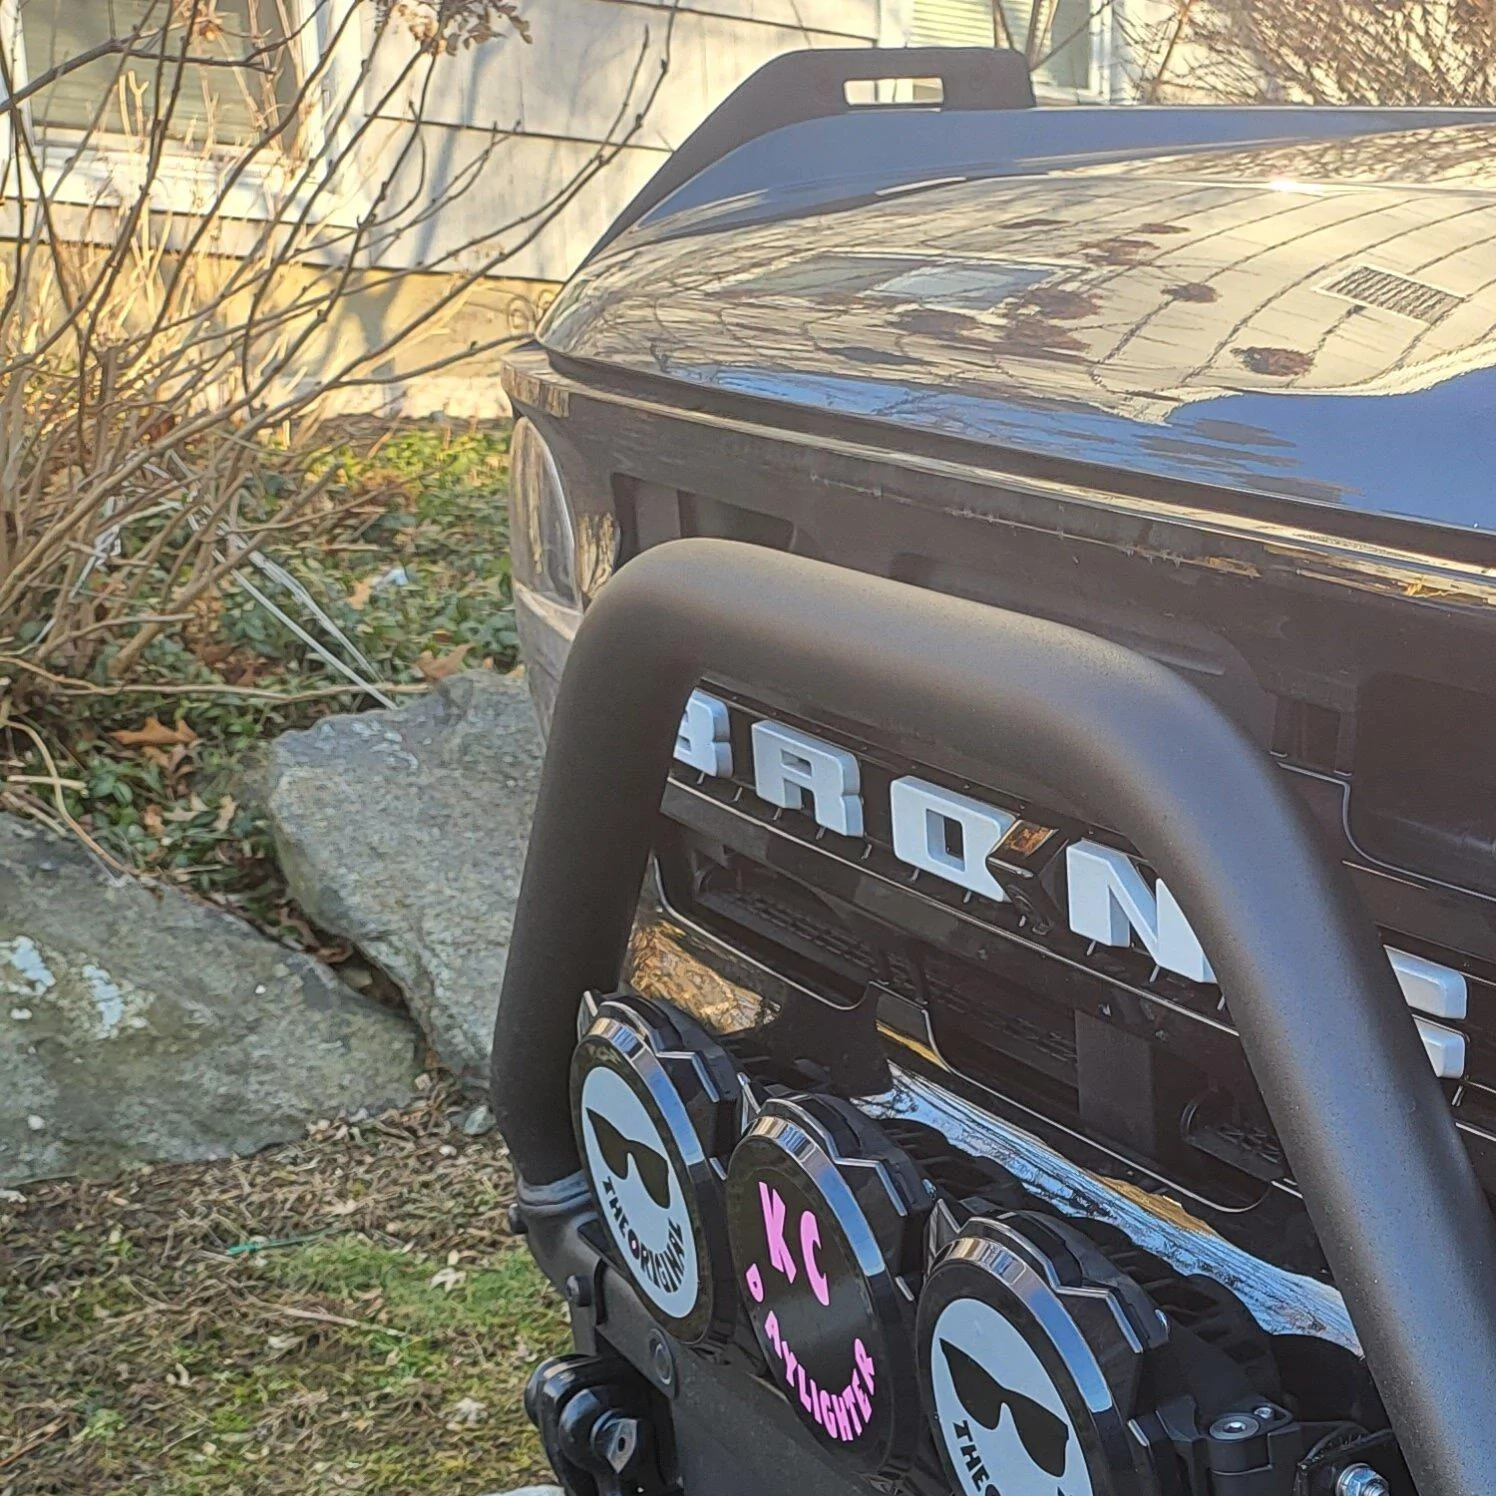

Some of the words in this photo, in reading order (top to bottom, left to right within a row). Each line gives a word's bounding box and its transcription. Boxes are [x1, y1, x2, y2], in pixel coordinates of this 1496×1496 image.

[602, 1175, 629, 1239] THE
[627, 1216, 685, 1293] ORIGINAL
[758, 1181, 830, 1307] KC
[953, 1420, 990, 1492] THE
